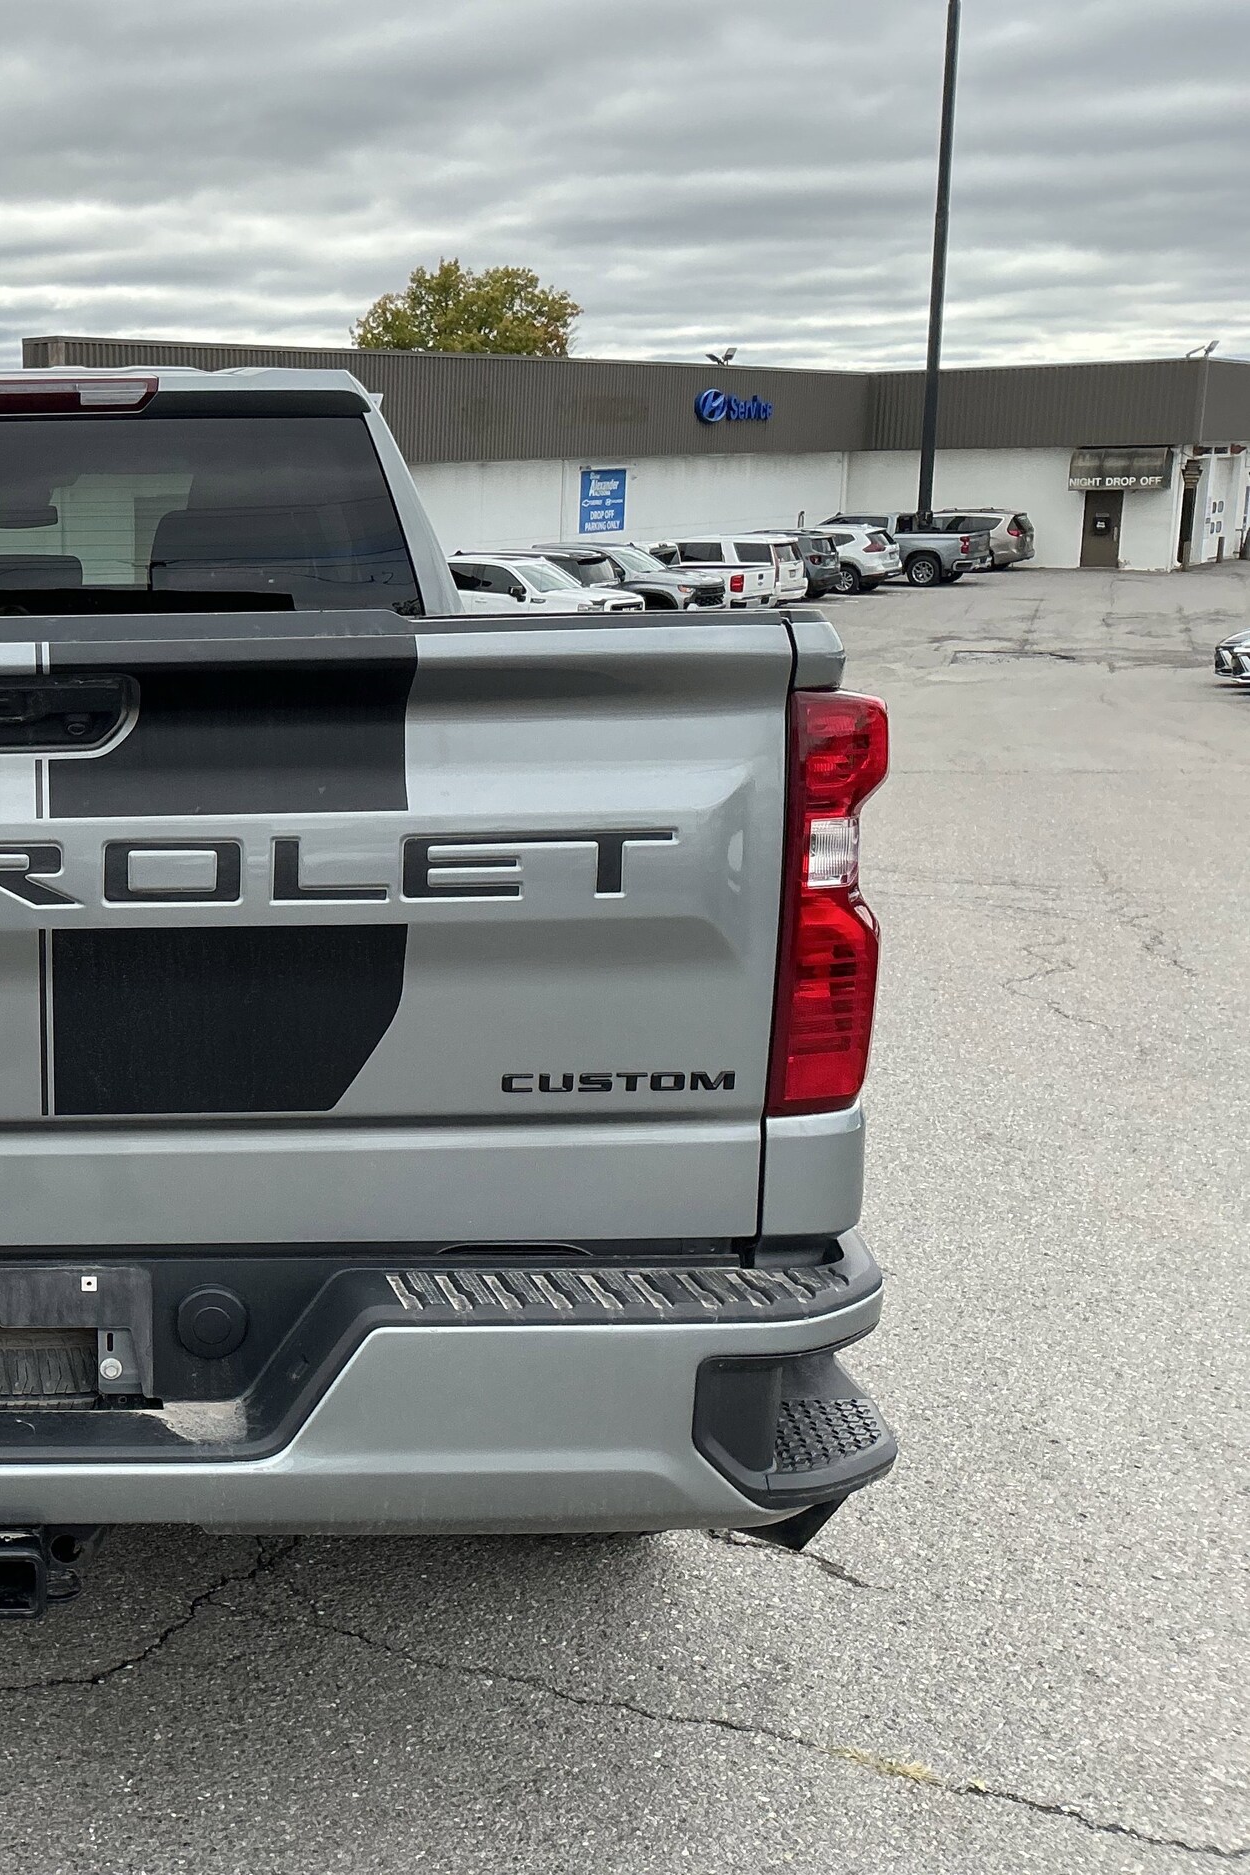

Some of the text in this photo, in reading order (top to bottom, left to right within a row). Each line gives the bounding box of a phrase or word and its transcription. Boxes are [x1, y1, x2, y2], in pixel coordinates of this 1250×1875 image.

[1069, 475, 1163, 487] NIGHT DROP OFF
[590, 509, 615, 520] DROP OFF
[584, 520, 620, 531] PARKING ONLY
[501, 1070, 736, 1093] CUSTOM
